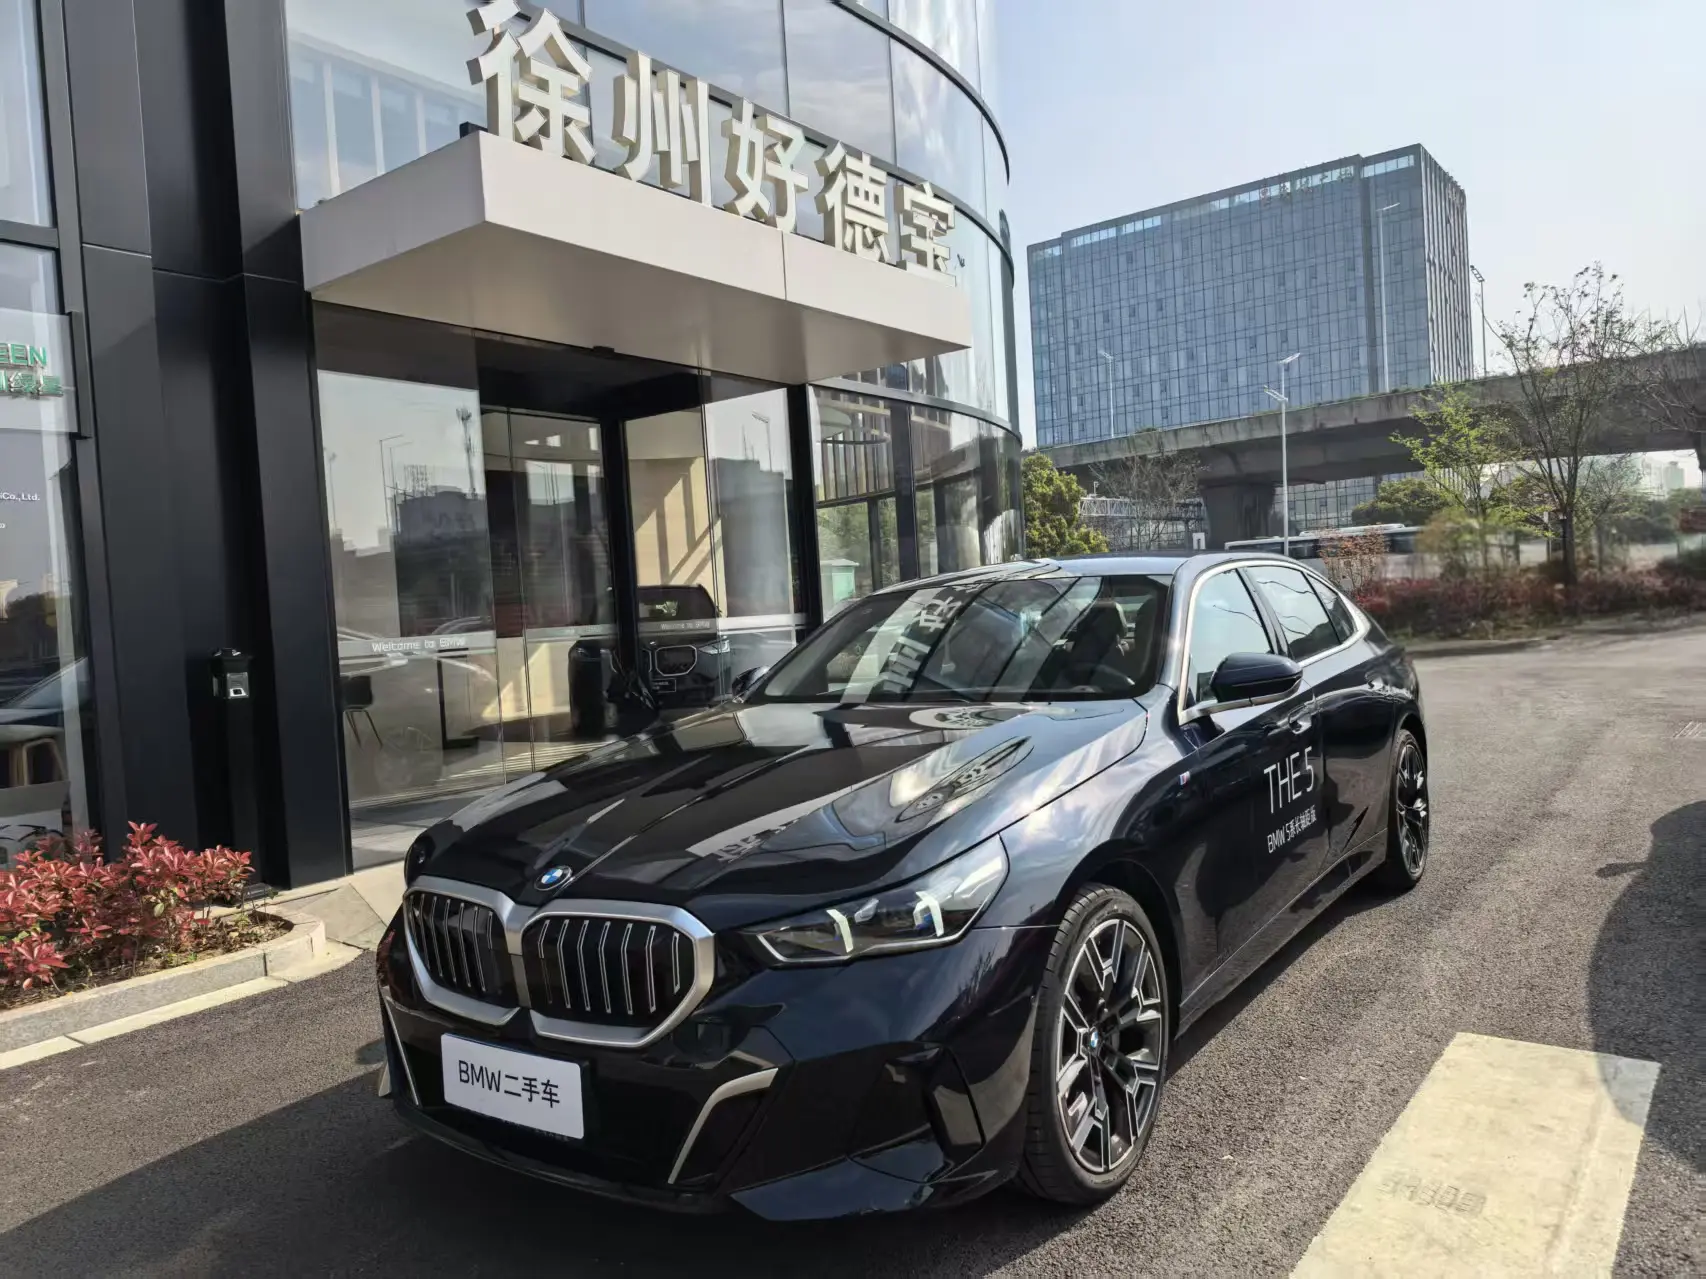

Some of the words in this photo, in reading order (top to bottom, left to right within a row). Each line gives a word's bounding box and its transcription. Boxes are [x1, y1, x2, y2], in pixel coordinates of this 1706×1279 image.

[466, 0, 957, 287] 徐州好德宝
[371, 641, 420, 652] Welcome
[424, 639, 436, 649] to
[439, 638, 466, 648] BMW
[1267, 826, 1286, 854] BMW
